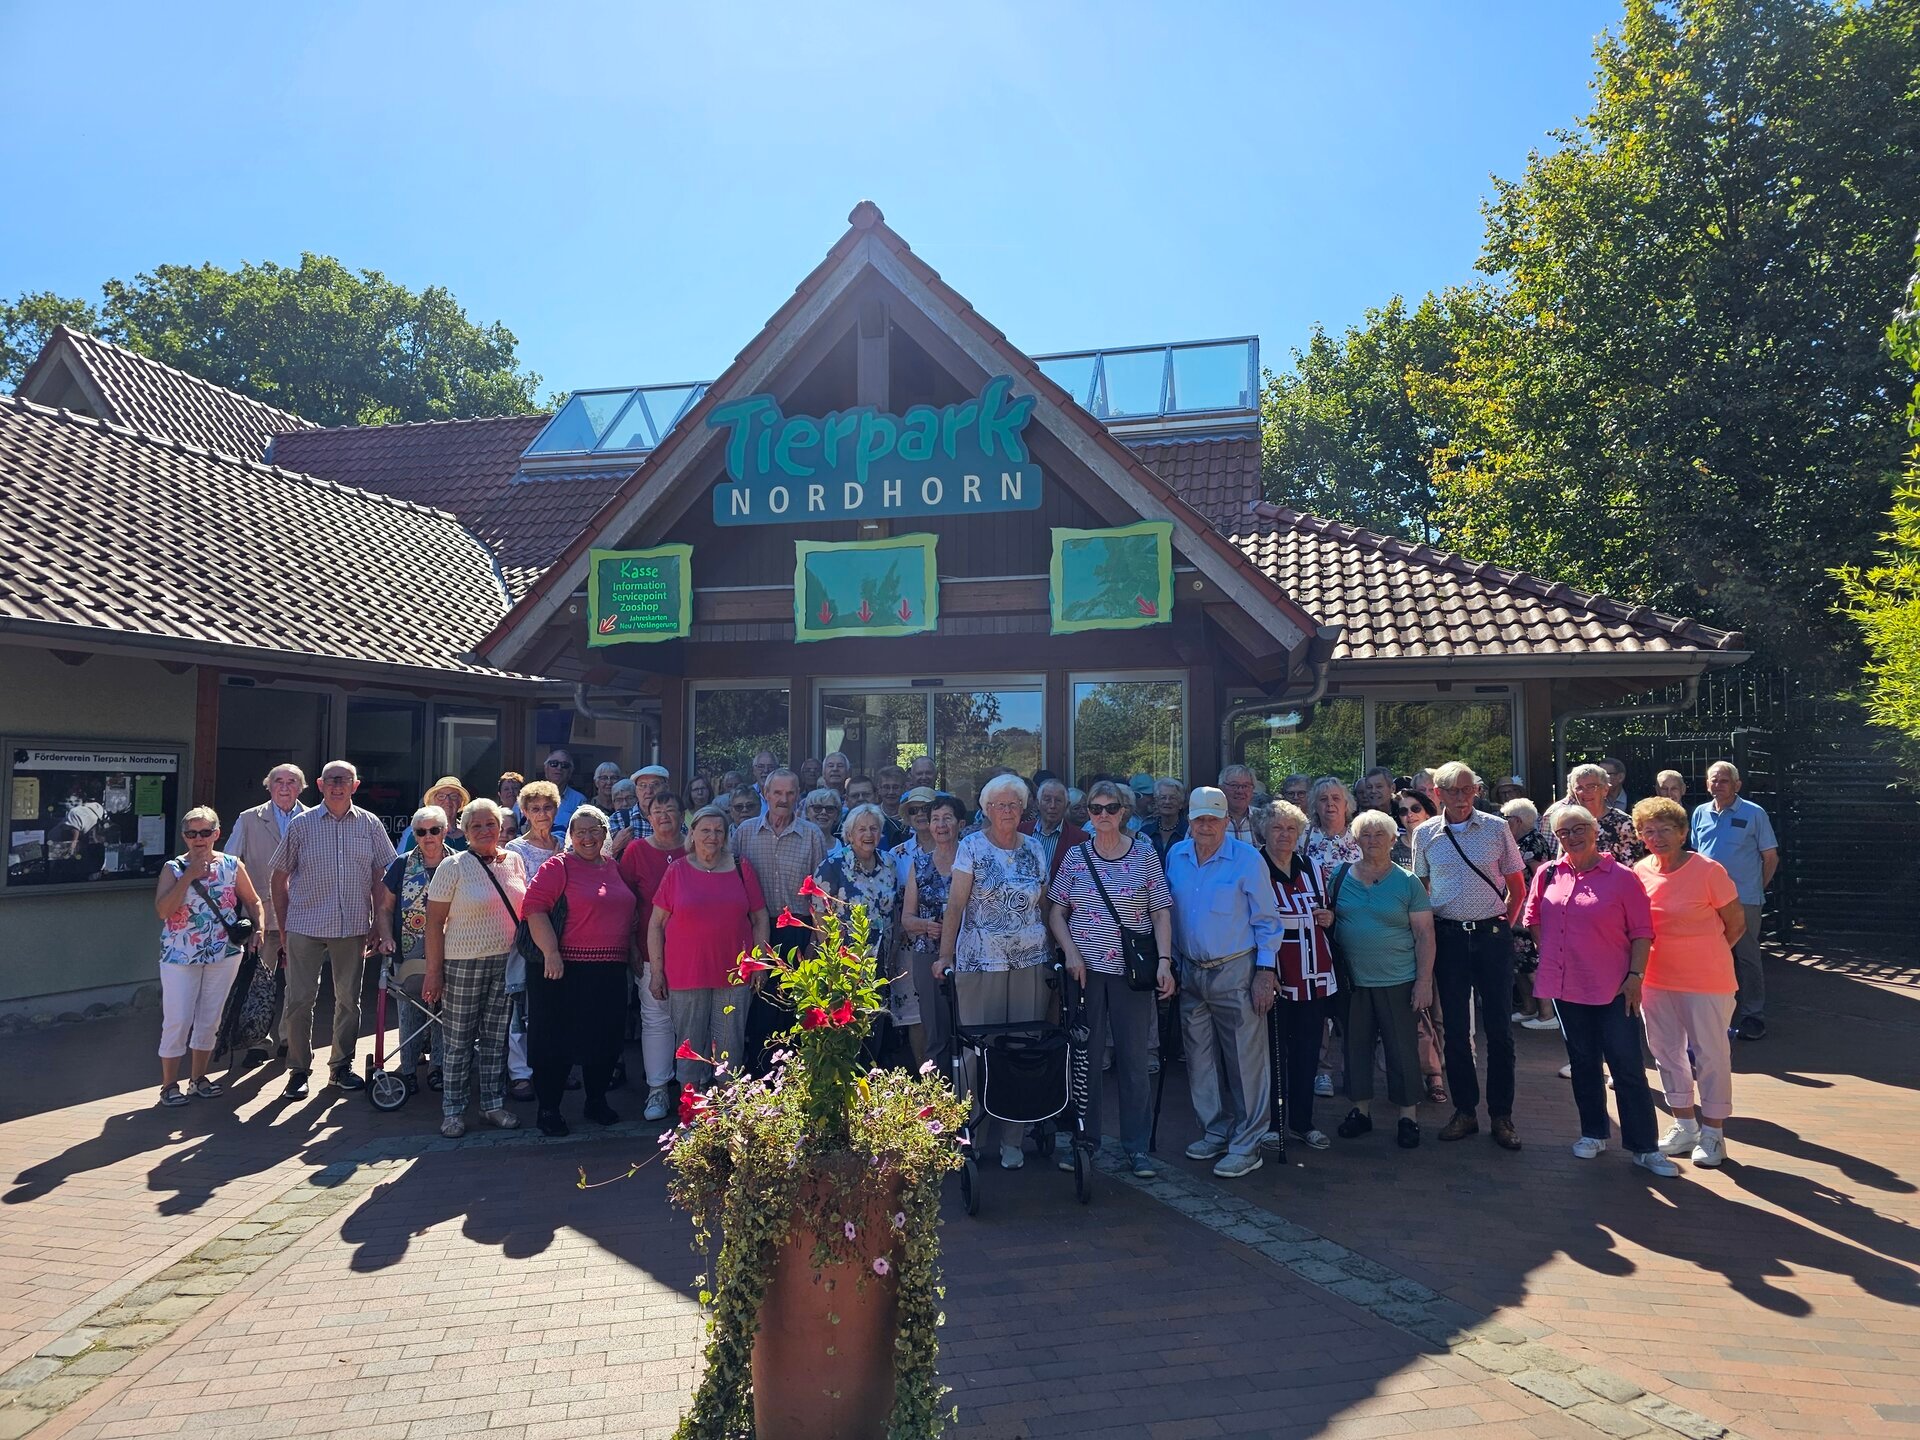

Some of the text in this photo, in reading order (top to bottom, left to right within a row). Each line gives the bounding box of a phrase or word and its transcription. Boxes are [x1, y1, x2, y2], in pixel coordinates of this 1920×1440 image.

[710, 379, 1034, 484] Tierpark
[731, 471, 1023, 516] NORDHORN
[620, 560, 658, 578] Kasse
[613, 581, 666, 591] Information
[612, 591, 667, 602] Servicepoint
[620, 602, 659, 612] Zooshop
[33, 752, 91, 763] Förderverein
[92, 754, 127, 764] Tierpark
[128, 755, 168, 765] Nordhorn
